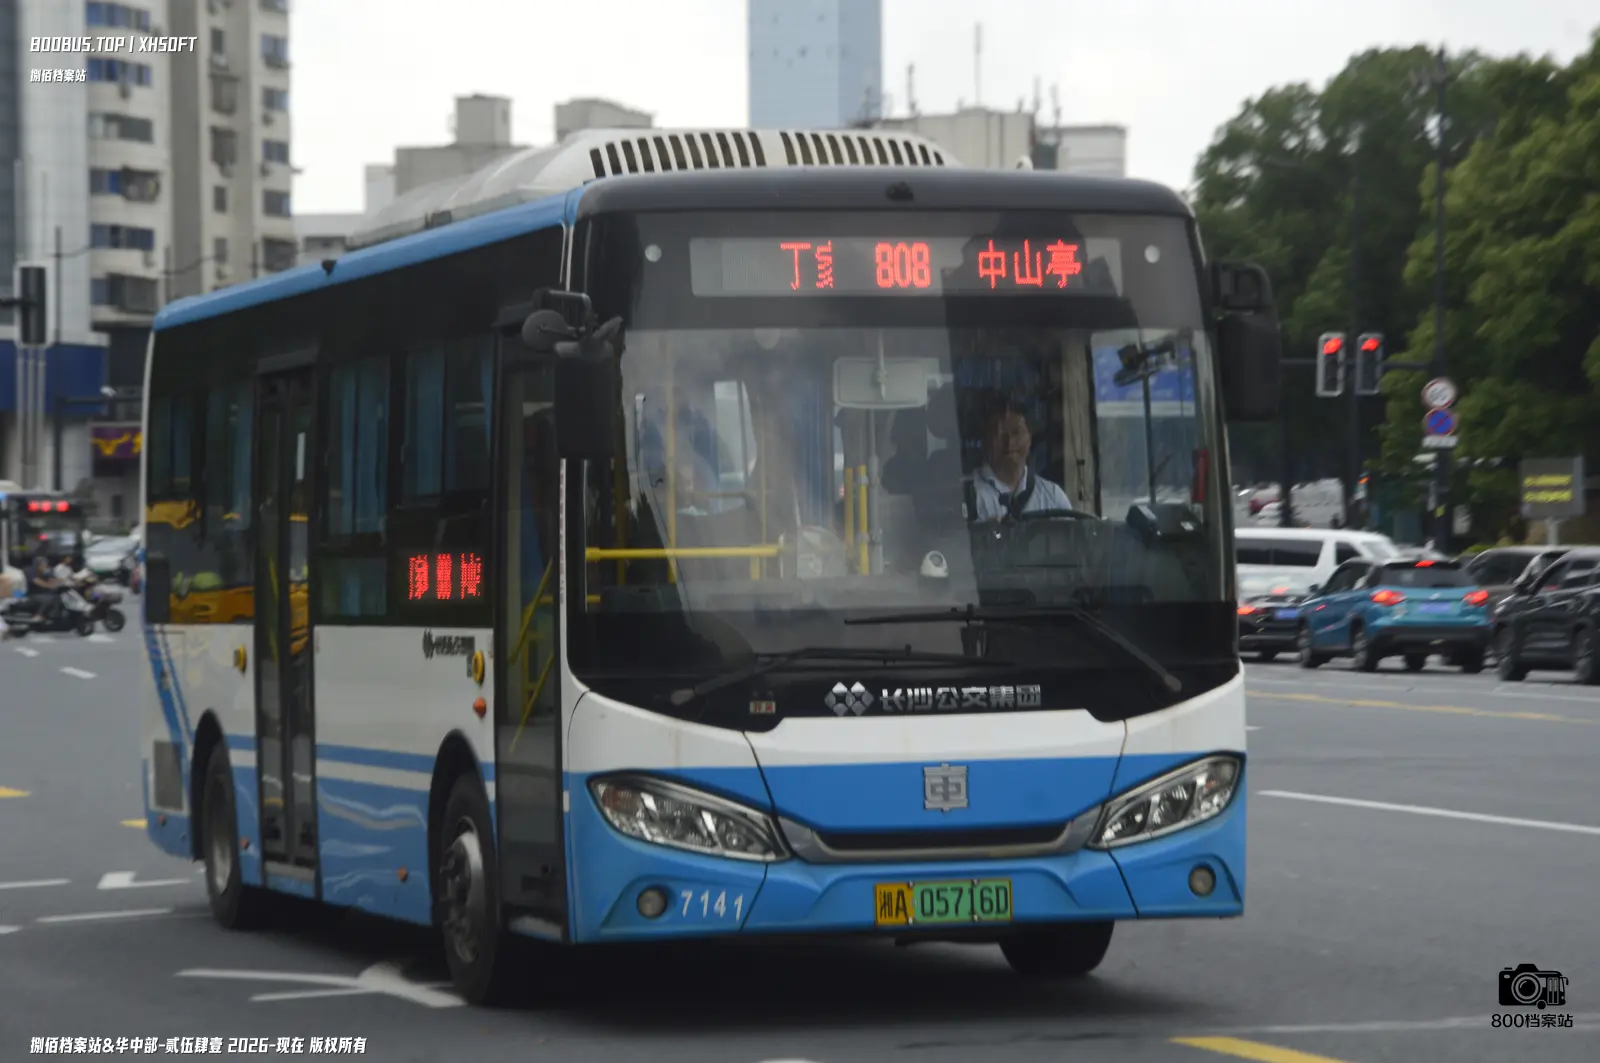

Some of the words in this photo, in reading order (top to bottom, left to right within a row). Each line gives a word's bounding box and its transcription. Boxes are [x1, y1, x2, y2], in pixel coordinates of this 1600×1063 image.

[876, 242, 931, 288] 808
[978, 239, 1081, 289] 中山亭
[681, 890, 743, 921] 7141
